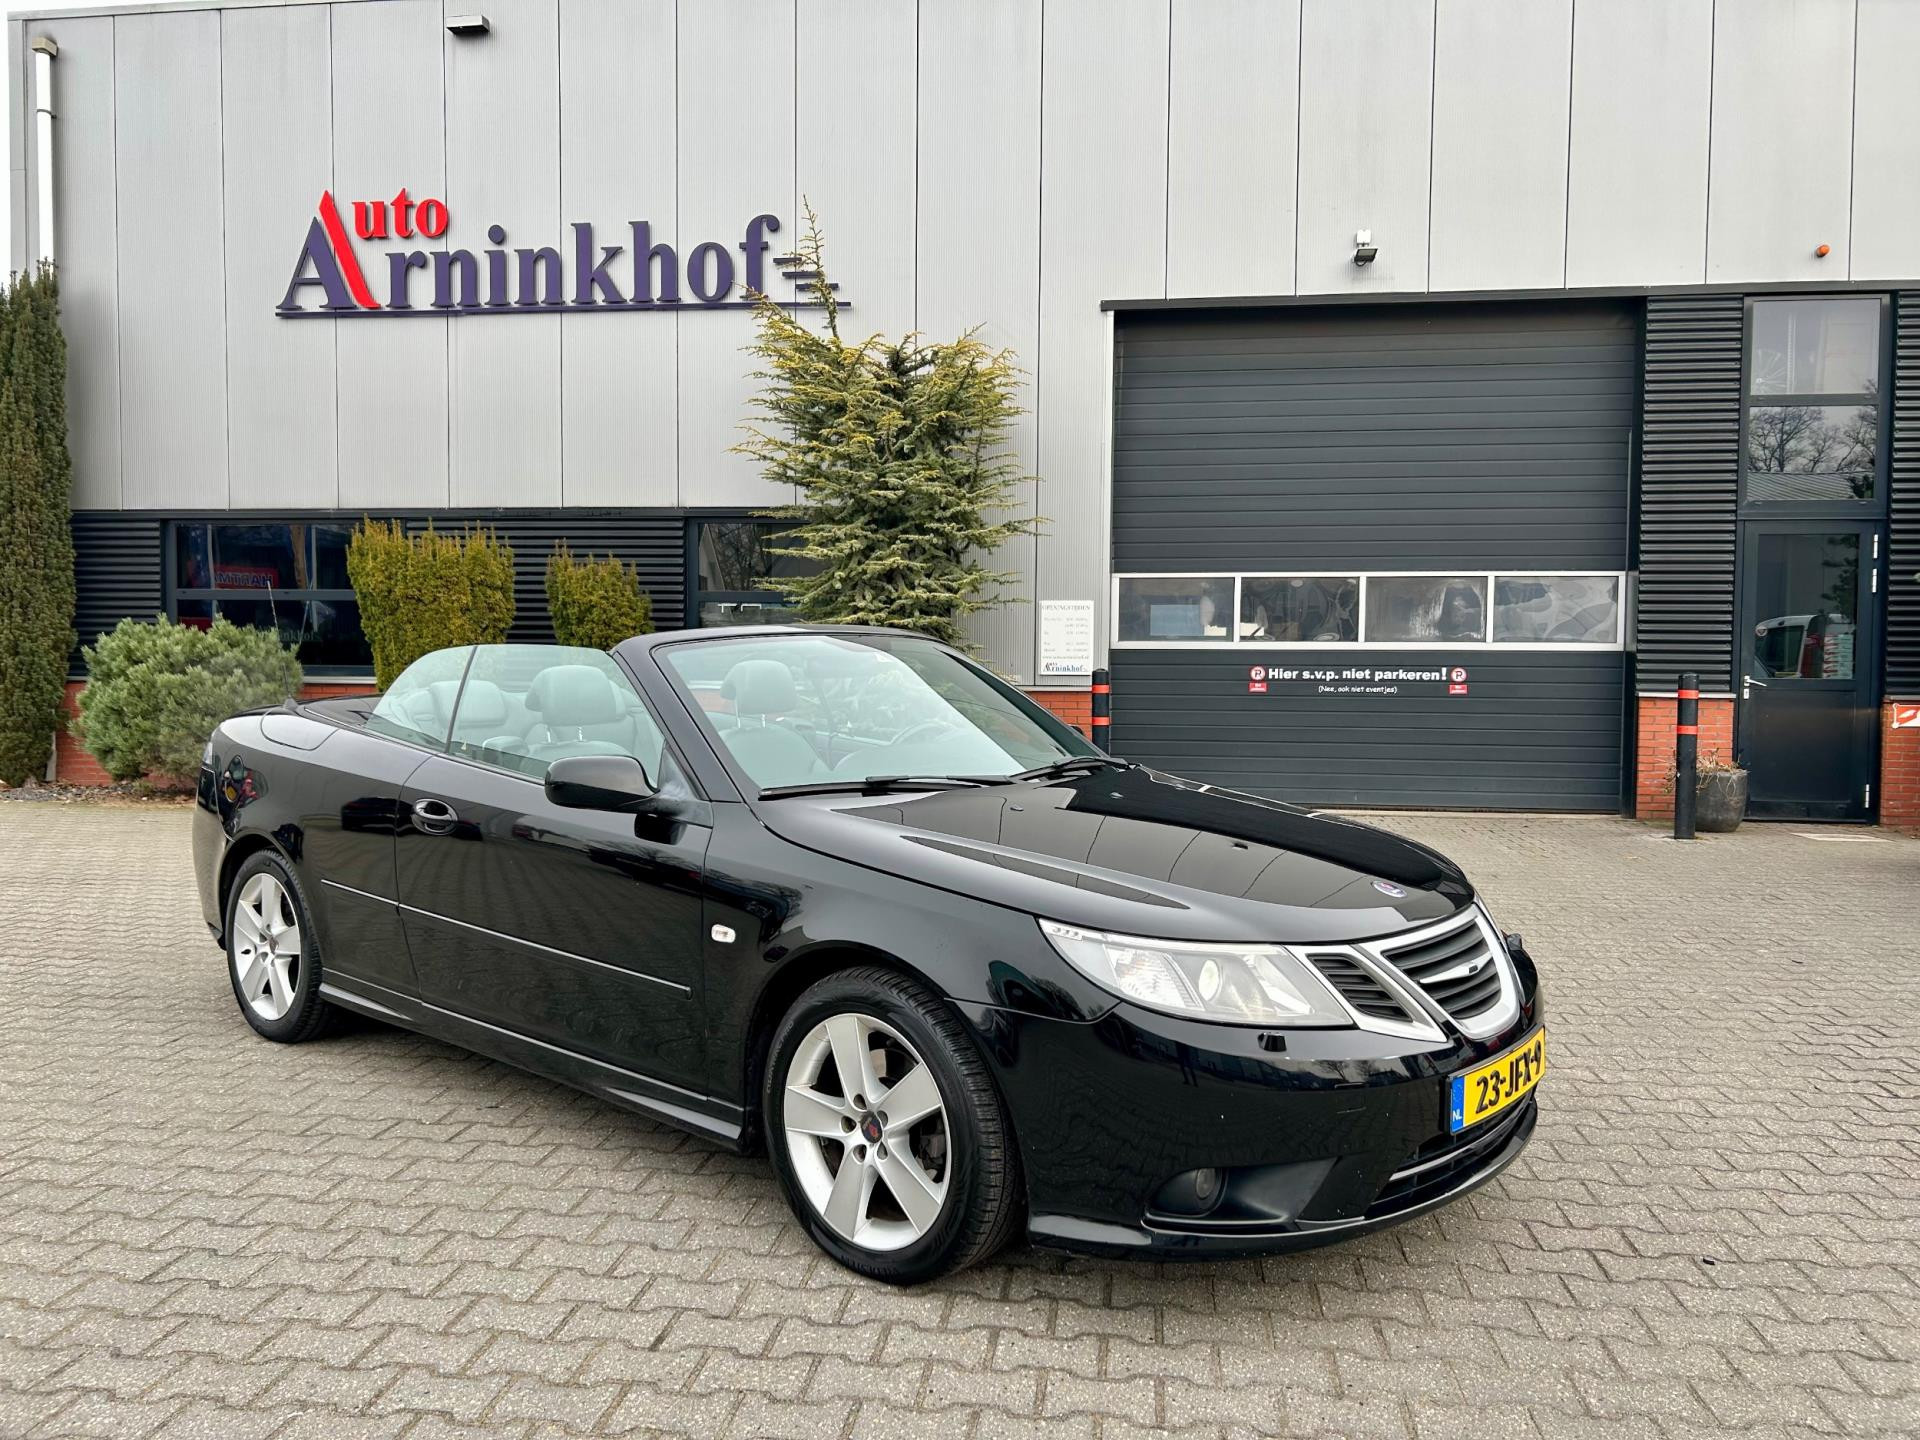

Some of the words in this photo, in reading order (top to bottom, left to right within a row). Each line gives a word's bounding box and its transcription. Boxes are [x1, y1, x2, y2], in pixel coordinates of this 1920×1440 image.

[278, 189, 781, 309] Arninkhof
[1268, 668, 1299, 679] Hier
[1302, 670, 1339, 681] s.v.p.
[1342, 668, 1370, 679] niet
[1374, 667, 1447, 682] parkeren!
[1318, 685, 1337, 693] (Nee,
[1365, 686, 1398, 694] eventjes)
[1475, 1040, 1542, 1114] 23-JFX-9
[1452, 1108, 1462, 1122] NL
